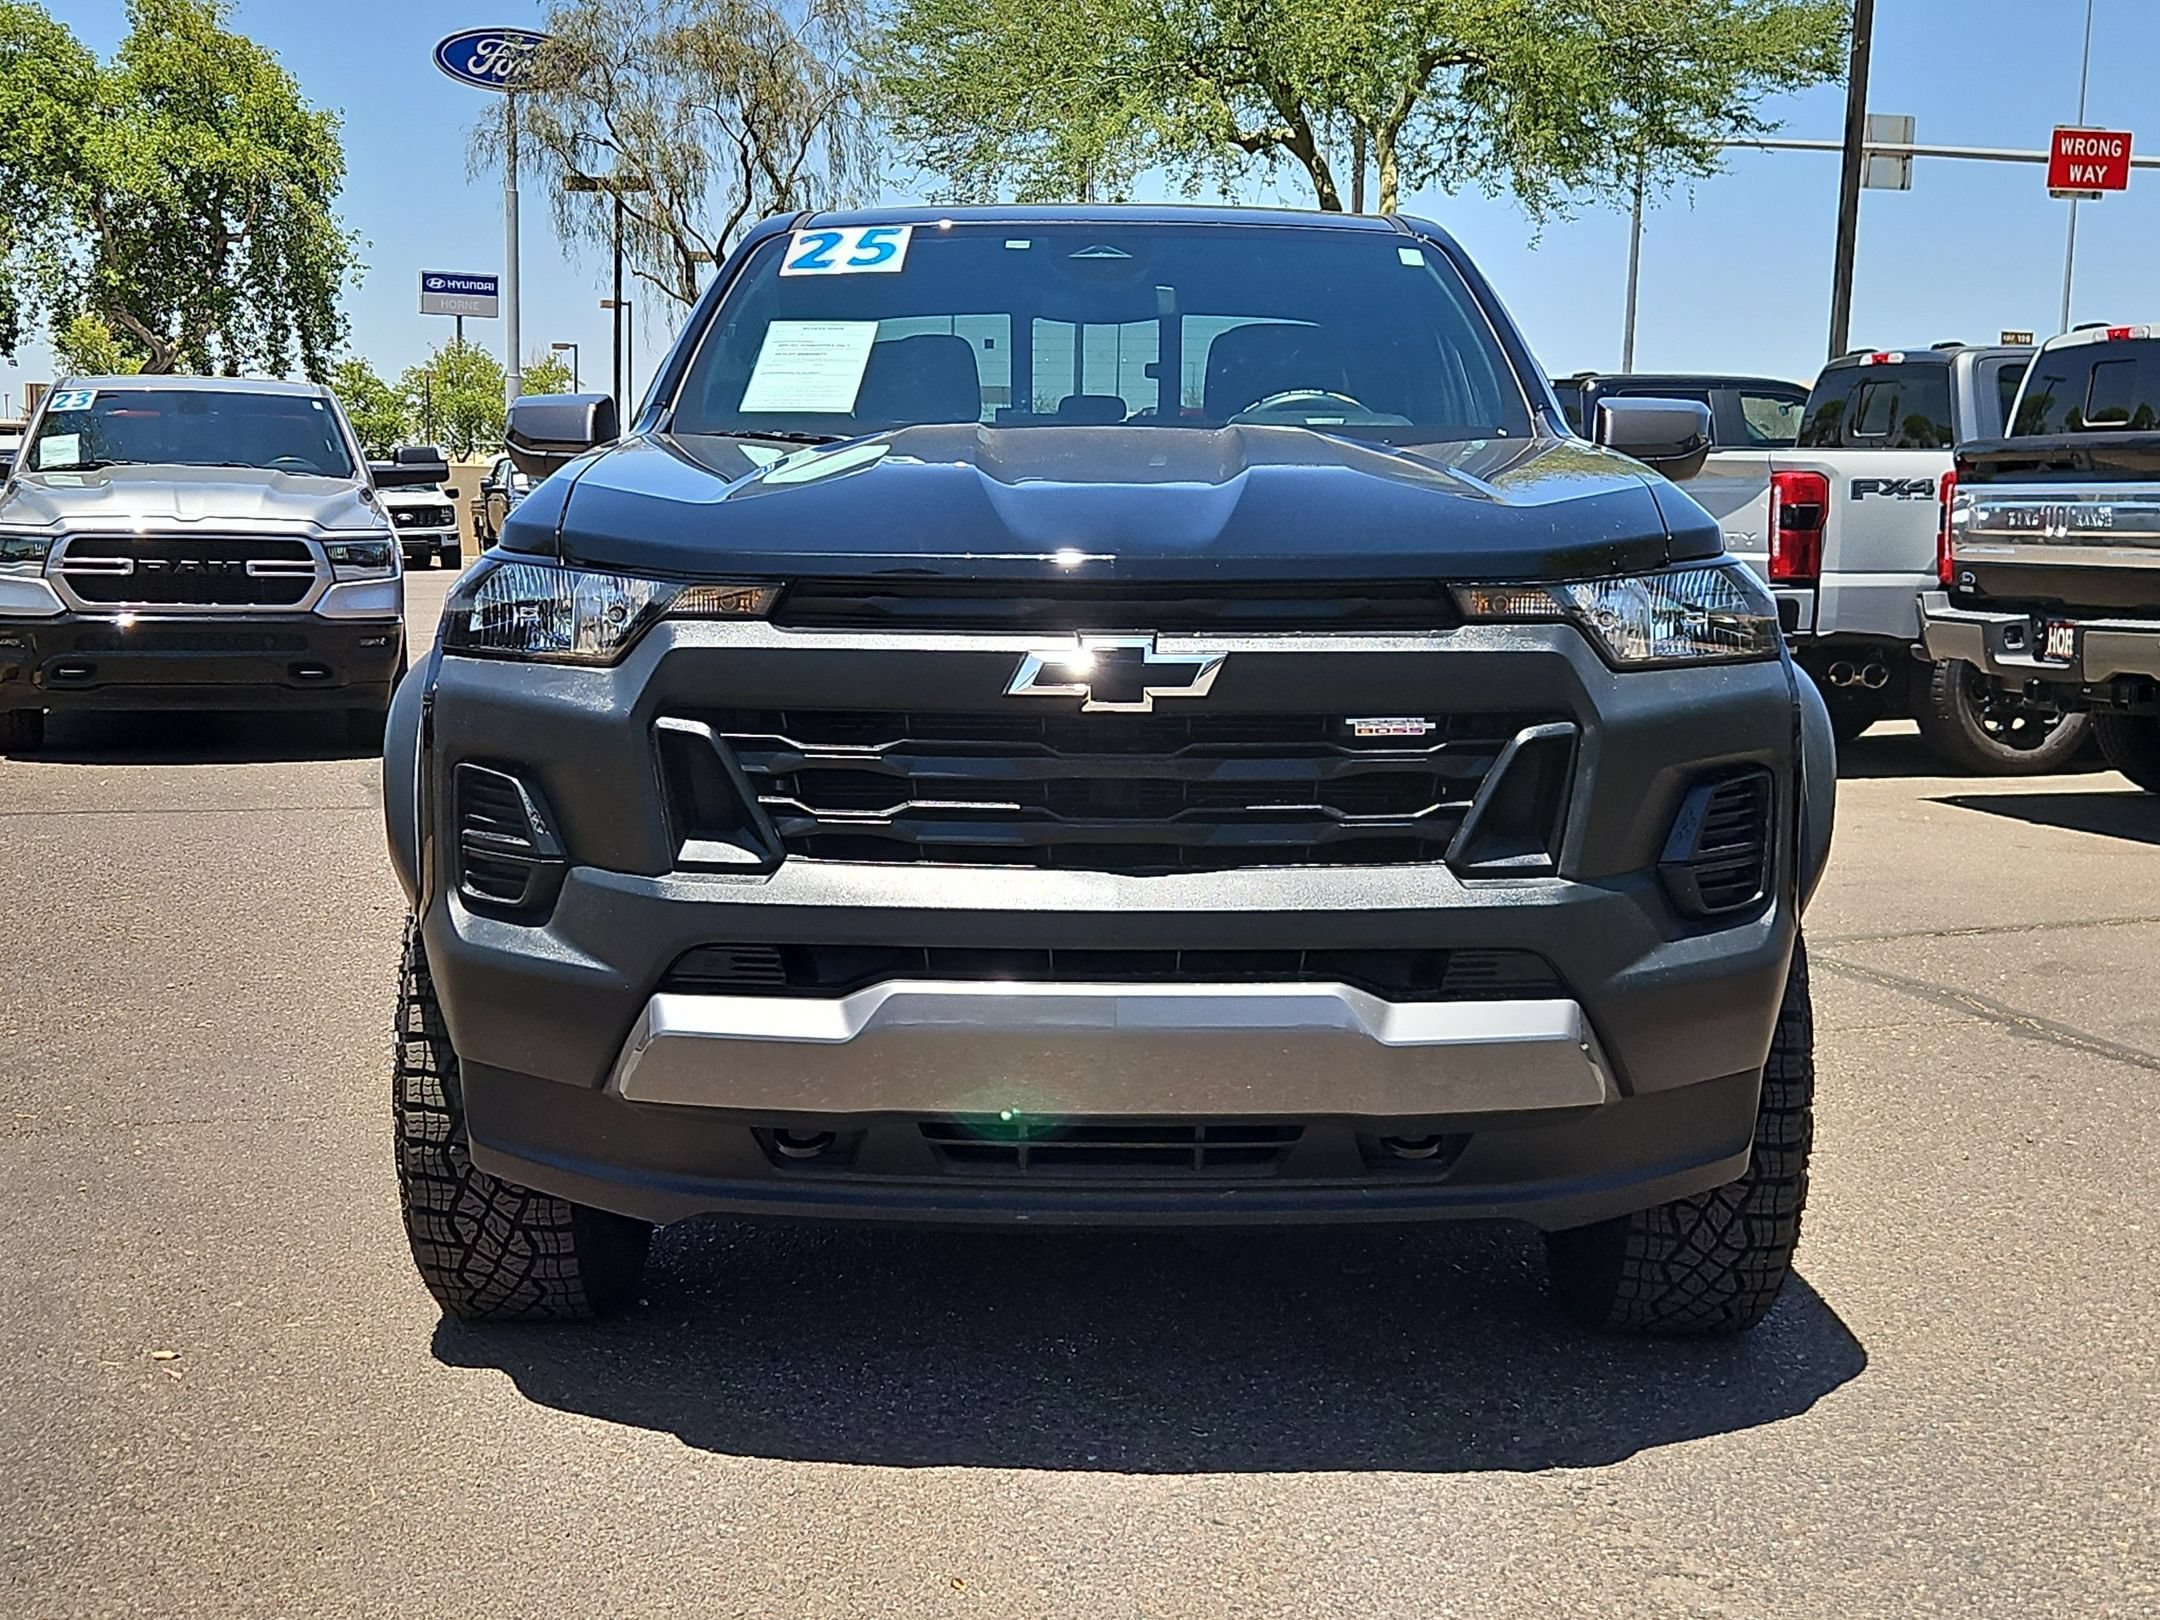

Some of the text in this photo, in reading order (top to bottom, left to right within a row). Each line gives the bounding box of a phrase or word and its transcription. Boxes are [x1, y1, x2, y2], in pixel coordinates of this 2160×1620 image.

[467, 38, 540, 76] For
[2061, 137, 2122, 157] WRONG
[2069, 164, 2108, 183] WAY
[788, 228, 902, 270] 25
[447, 279, 495, 291] HYUNDAI
[440, 299, 480, 311] HORNE
[52, 391, 93, 409] 23
[1850, 478, 1935, 500] FX4
[2045, 626, 2074, 657] HOR
